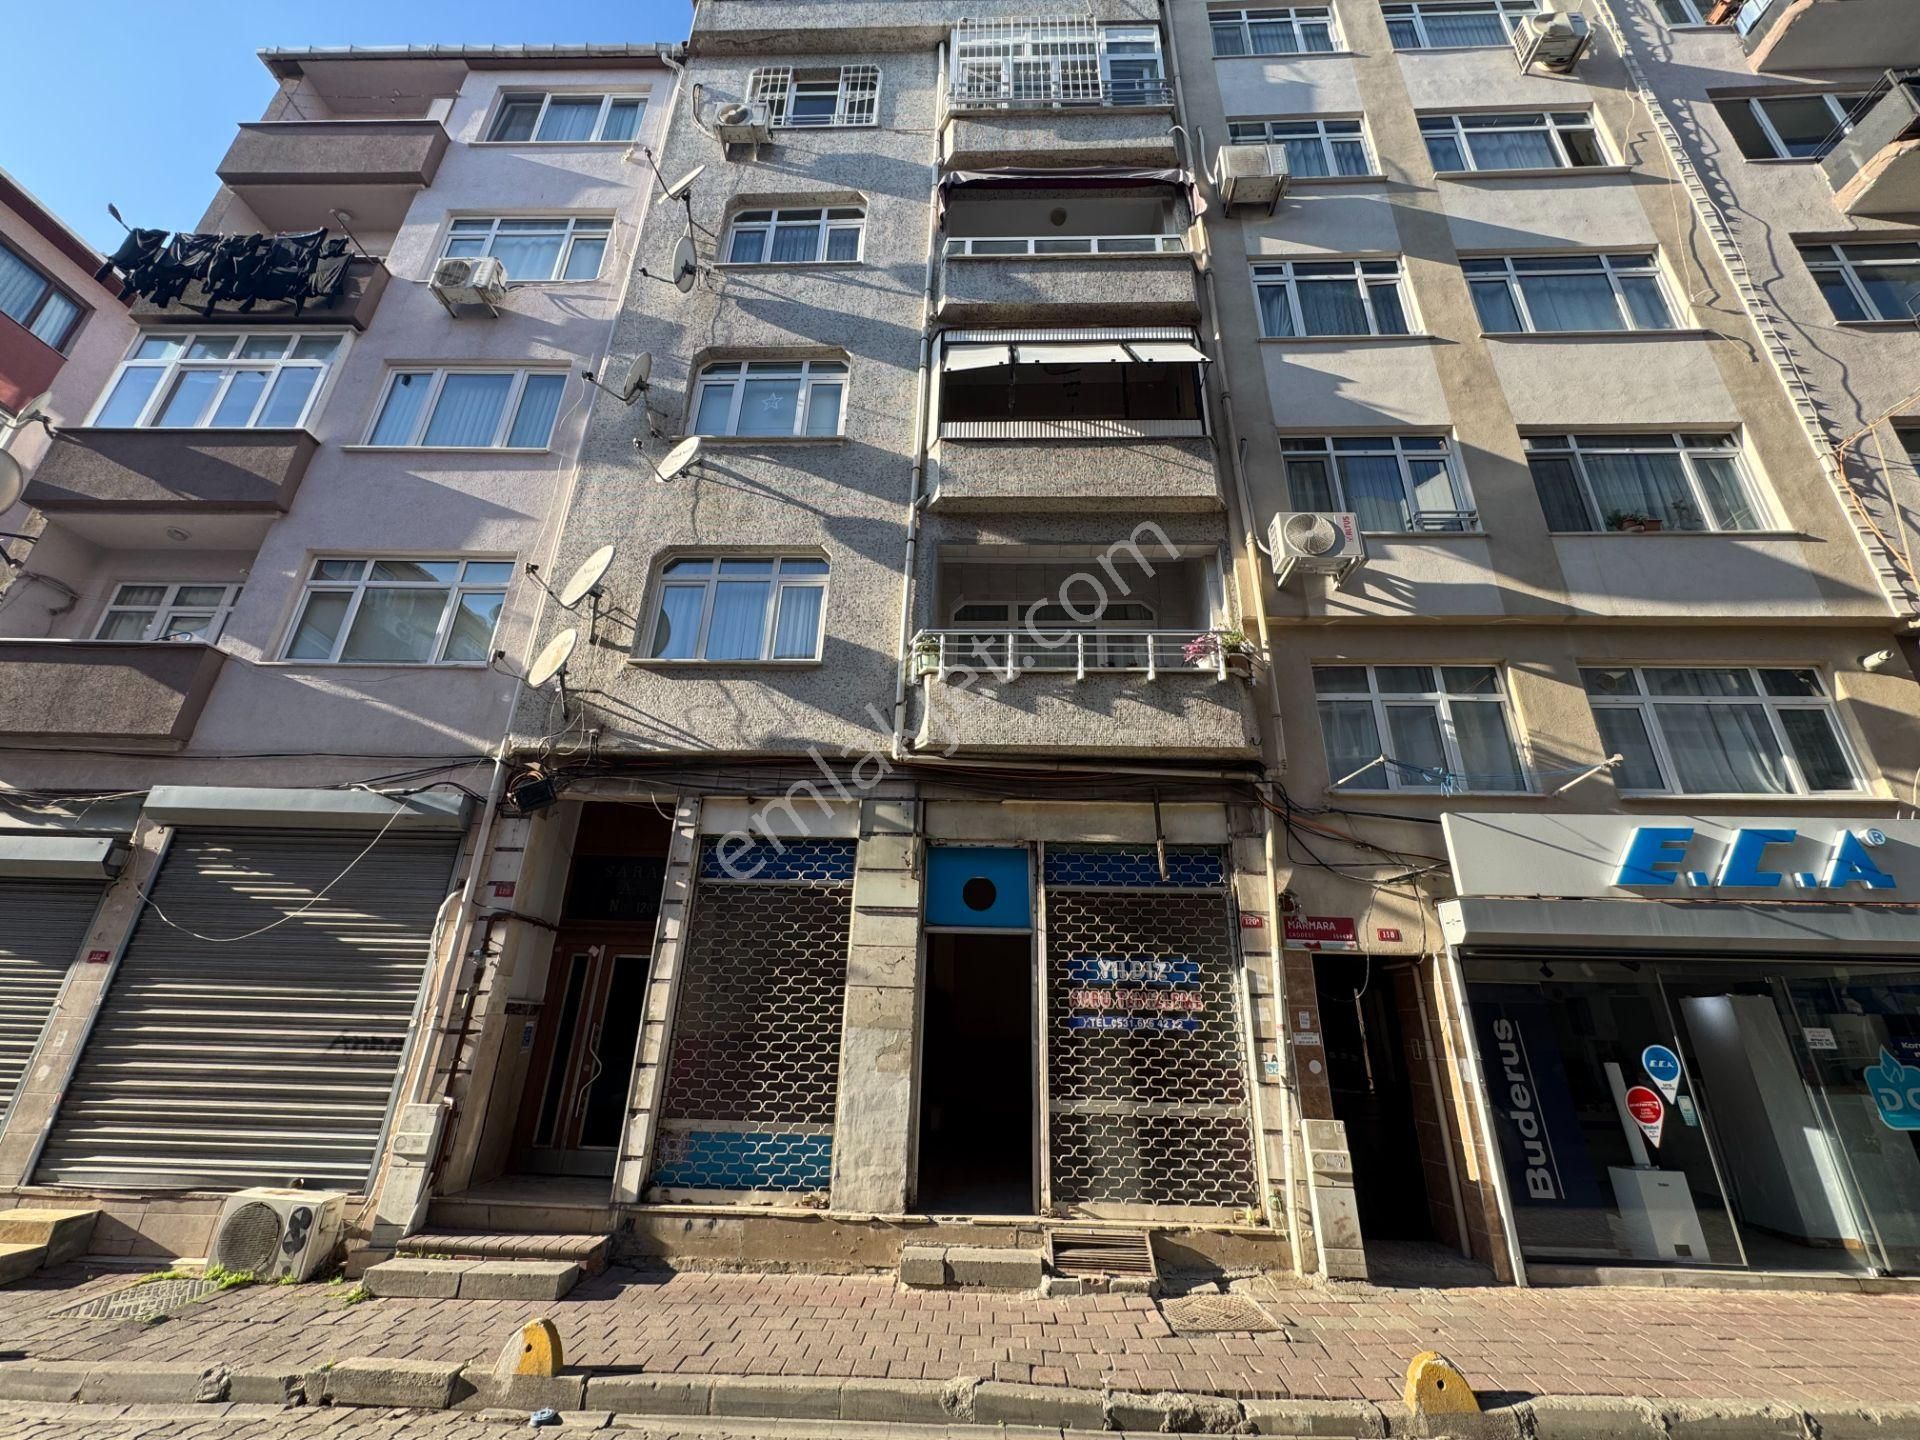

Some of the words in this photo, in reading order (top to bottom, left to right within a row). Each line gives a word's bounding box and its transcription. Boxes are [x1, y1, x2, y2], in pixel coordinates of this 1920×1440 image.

[1287, 919, 1337, 931] MARMARA
[1098, 959, 1168, 980] YILDIZ
[1493, 1018, 1557, 1199] Buderus
